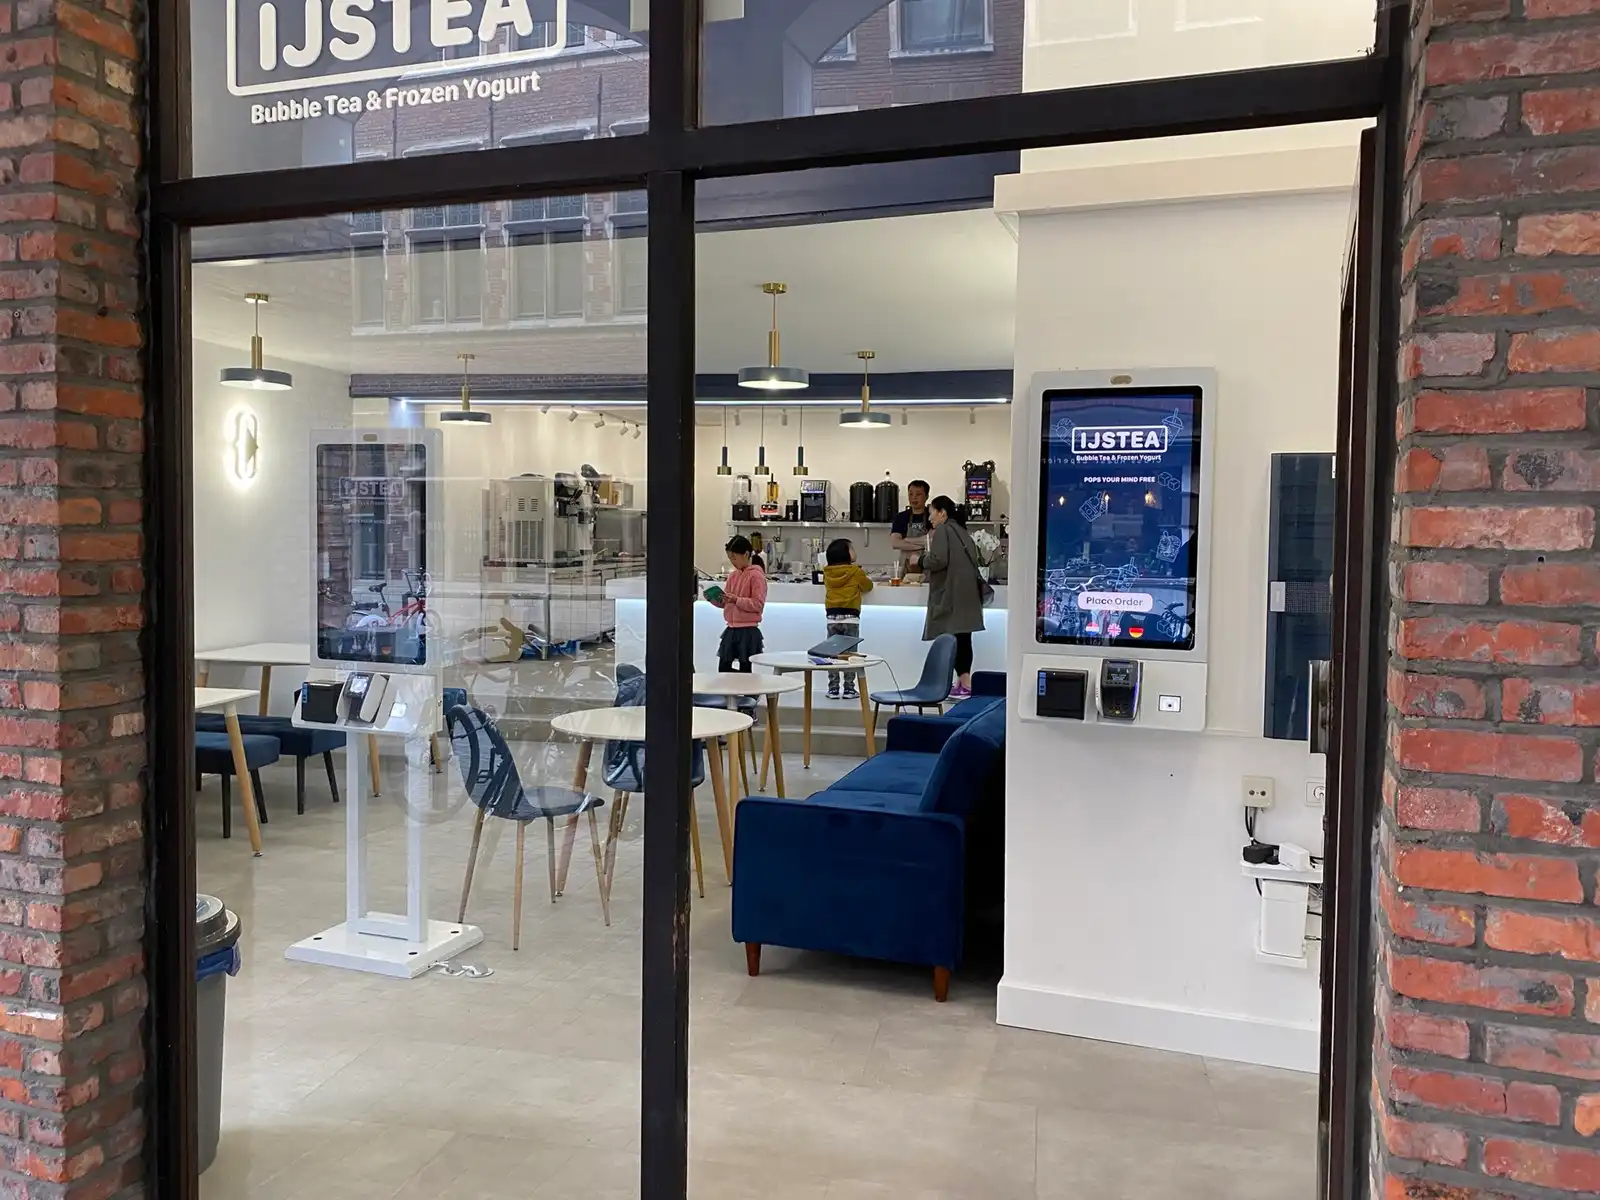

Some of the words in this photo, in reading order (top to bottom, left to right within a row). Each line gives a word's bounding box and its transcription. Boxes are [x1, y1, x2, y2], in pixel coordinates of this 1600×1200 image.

[259, 0, 534, 71] IJSTEA
[251, 97, 322, 124] Bubble
[324, 94, 362, 115] Tea
[366, 89, 382, 111] &
[385, 84, 460, 109] Frozen
[463, 70, 541, 102] Yogurt
[1080, 430, 1160, 450] IJSTEA
[1139, 454, 1162, 462] Yogurt
[1086, 597, 1113, 605] Place
[1114, 597, 1144, 606] Order
